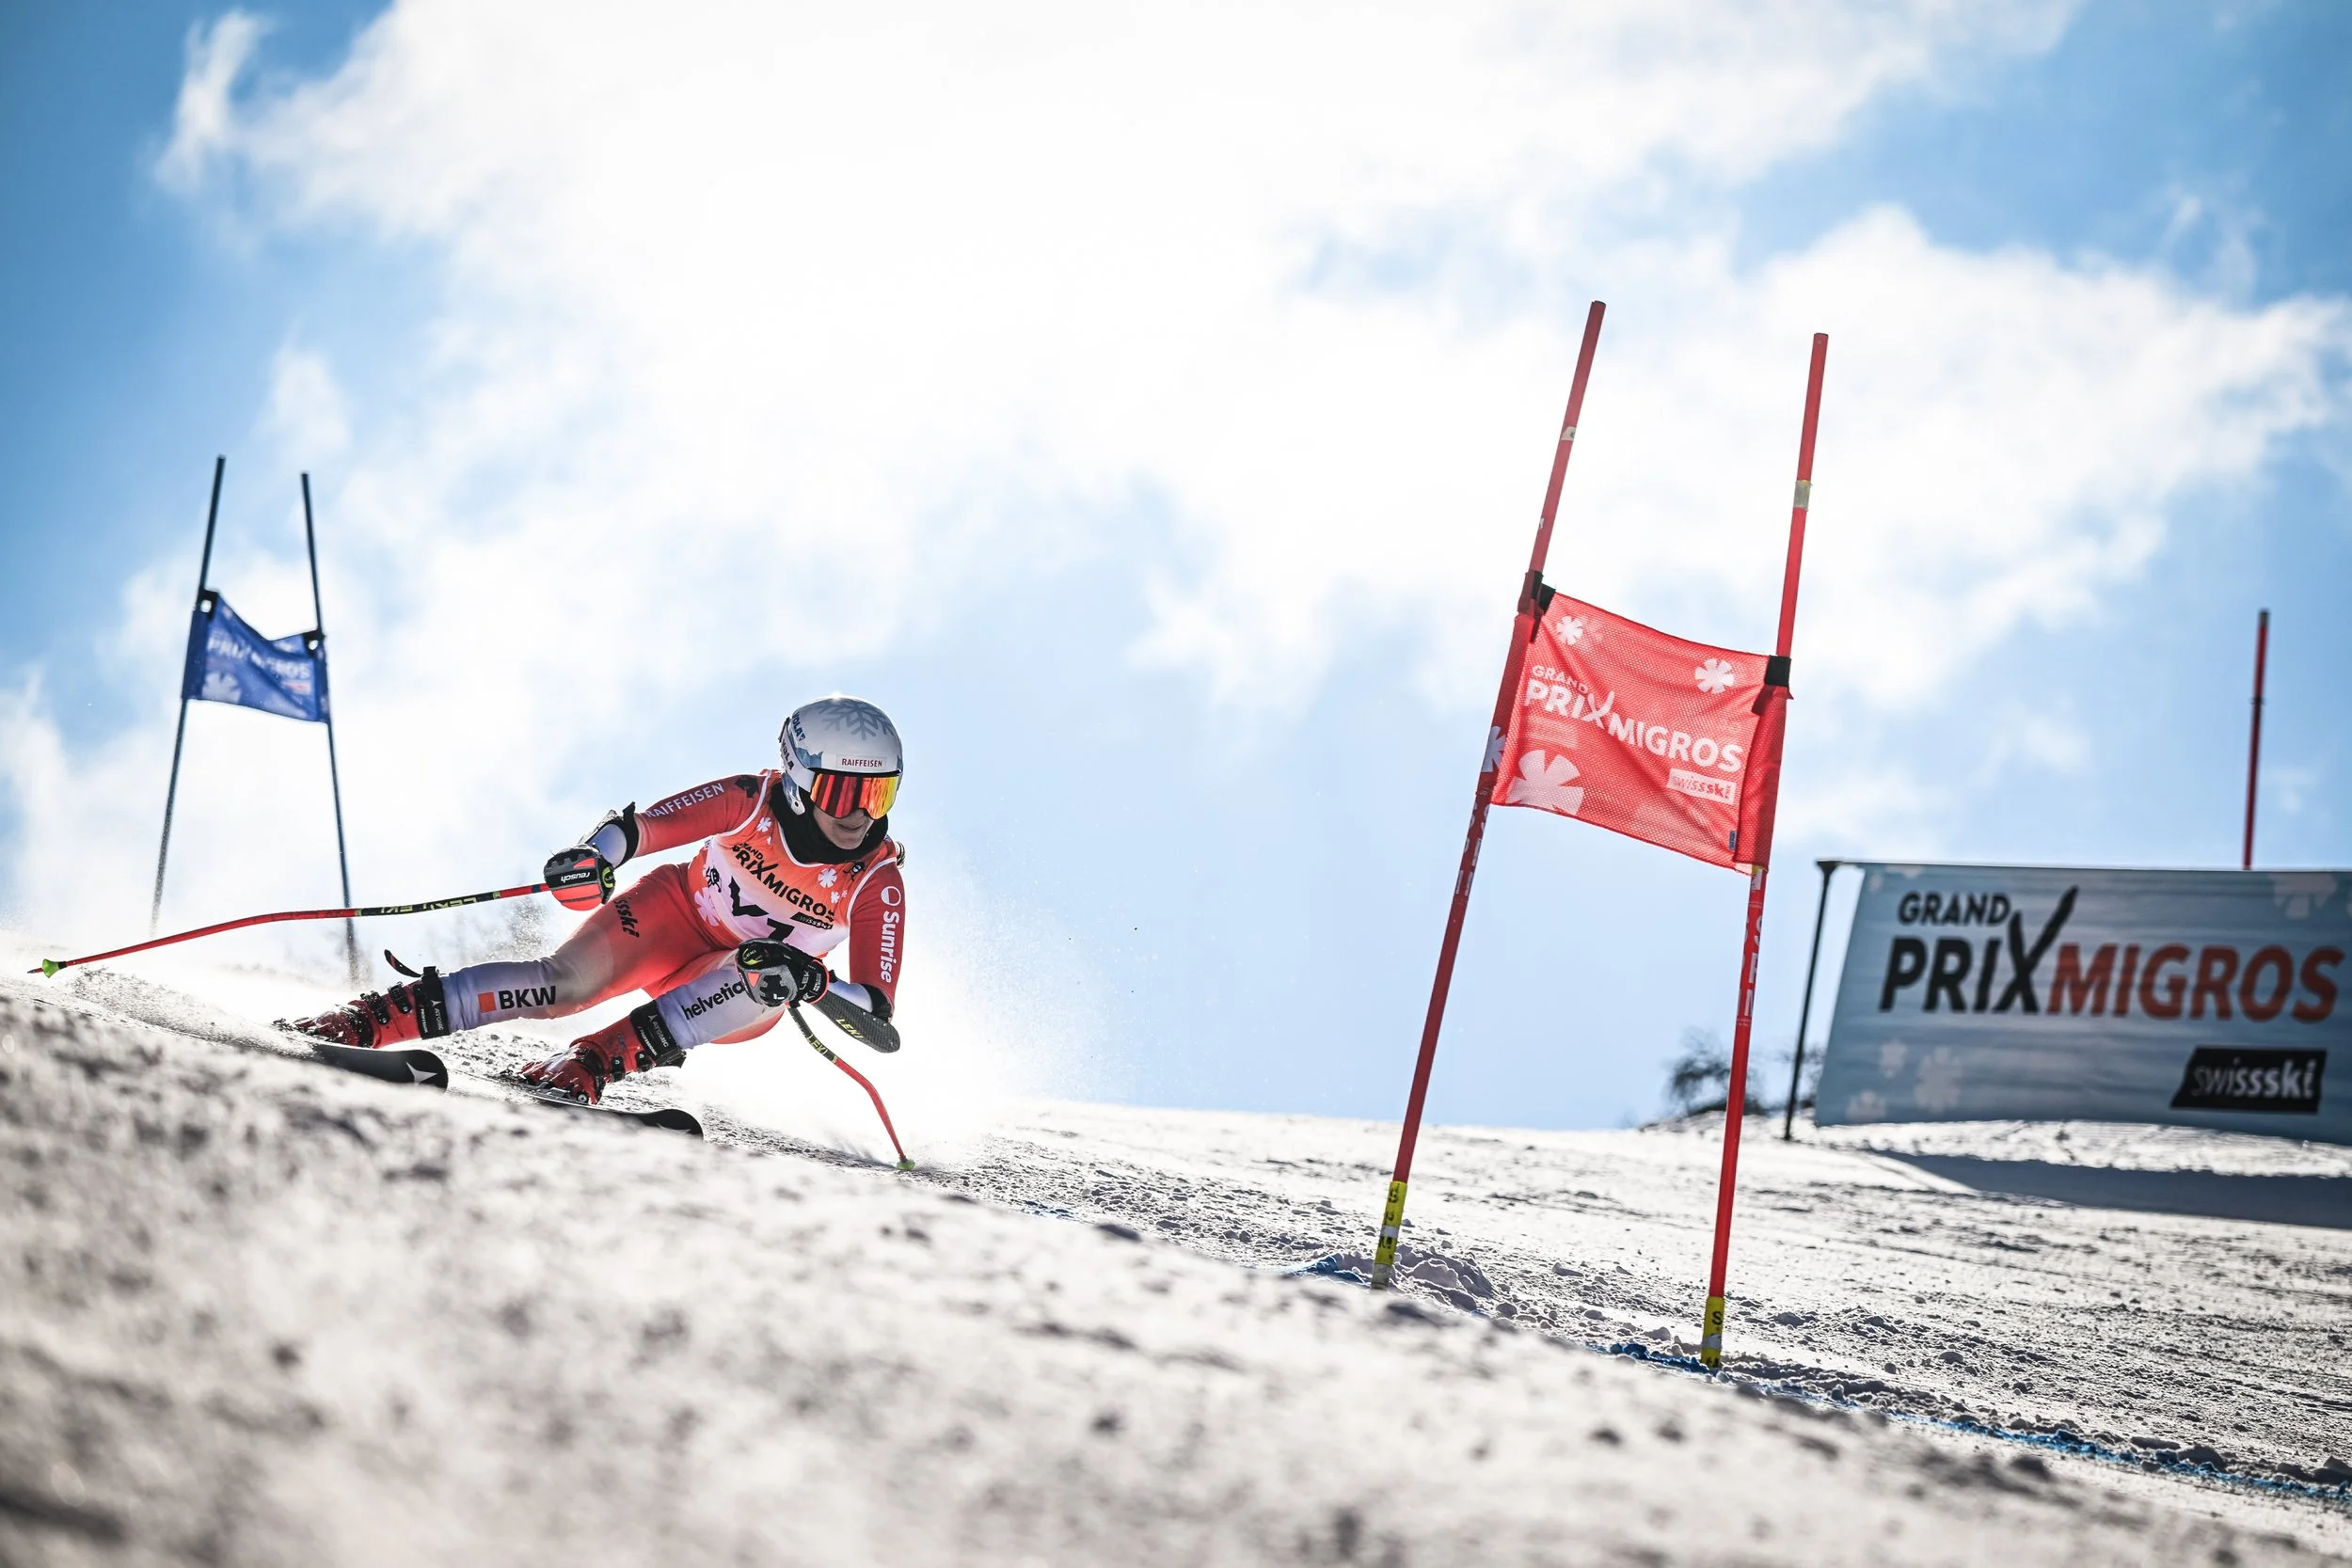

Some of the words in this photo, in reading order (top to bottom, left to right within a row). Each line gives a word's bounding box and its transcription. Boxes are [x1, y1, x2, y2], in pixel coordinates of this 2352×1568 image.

[1531, 665, 1588, 694] GRAND
[1525, 678, 1615, 729] PRIX
[1608, 712, 1743, 773] MIGROS
[841, 758, 882, 768] RAIFFEISEN
[644, 783, 725, 817] RAIFFEISEN
[561, 872, 590, 883] reusch
[1898, 891, 2011, 927] GRAND
[881, 911, 900, 983] Sunrise
[1878, 885, 2079, 1013] PRIX
[2046, 942, 2346, 1022] MIGROS
[498, 985, 557, 1010] BKW
[680, 981, 745, 1020] helvetia
[835, 1019, 864, 1038] LEKI
[2191, 1056, 2316, 1100] swissski
